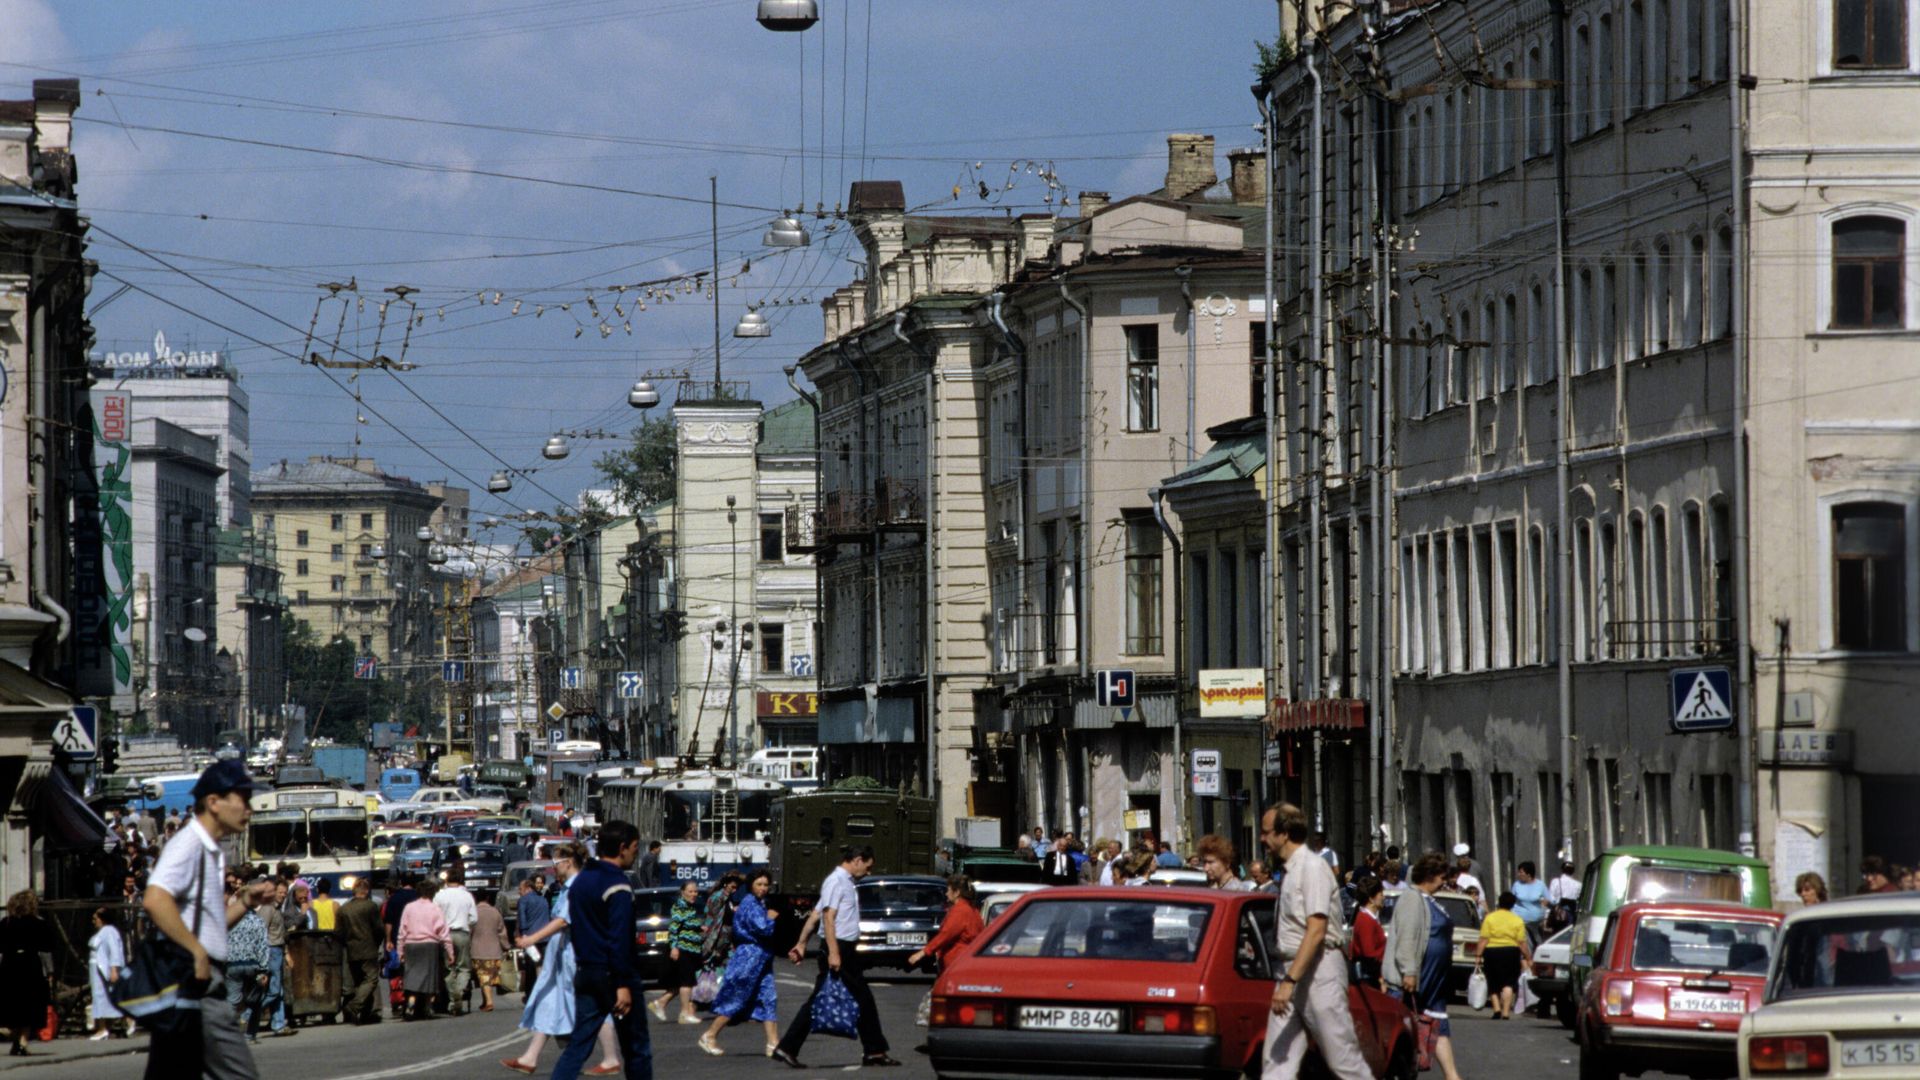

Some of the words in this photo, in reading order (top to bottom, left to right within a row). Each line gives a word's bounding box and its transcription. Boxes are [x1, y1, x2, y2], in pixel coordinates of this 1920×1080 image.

[104, 352, 150, 368] ДОМ
[1793, 698, 1801, 718] 1
[676, 866, 709, 880] 6645
[1025, 1008, 1065, 1027] ММР
